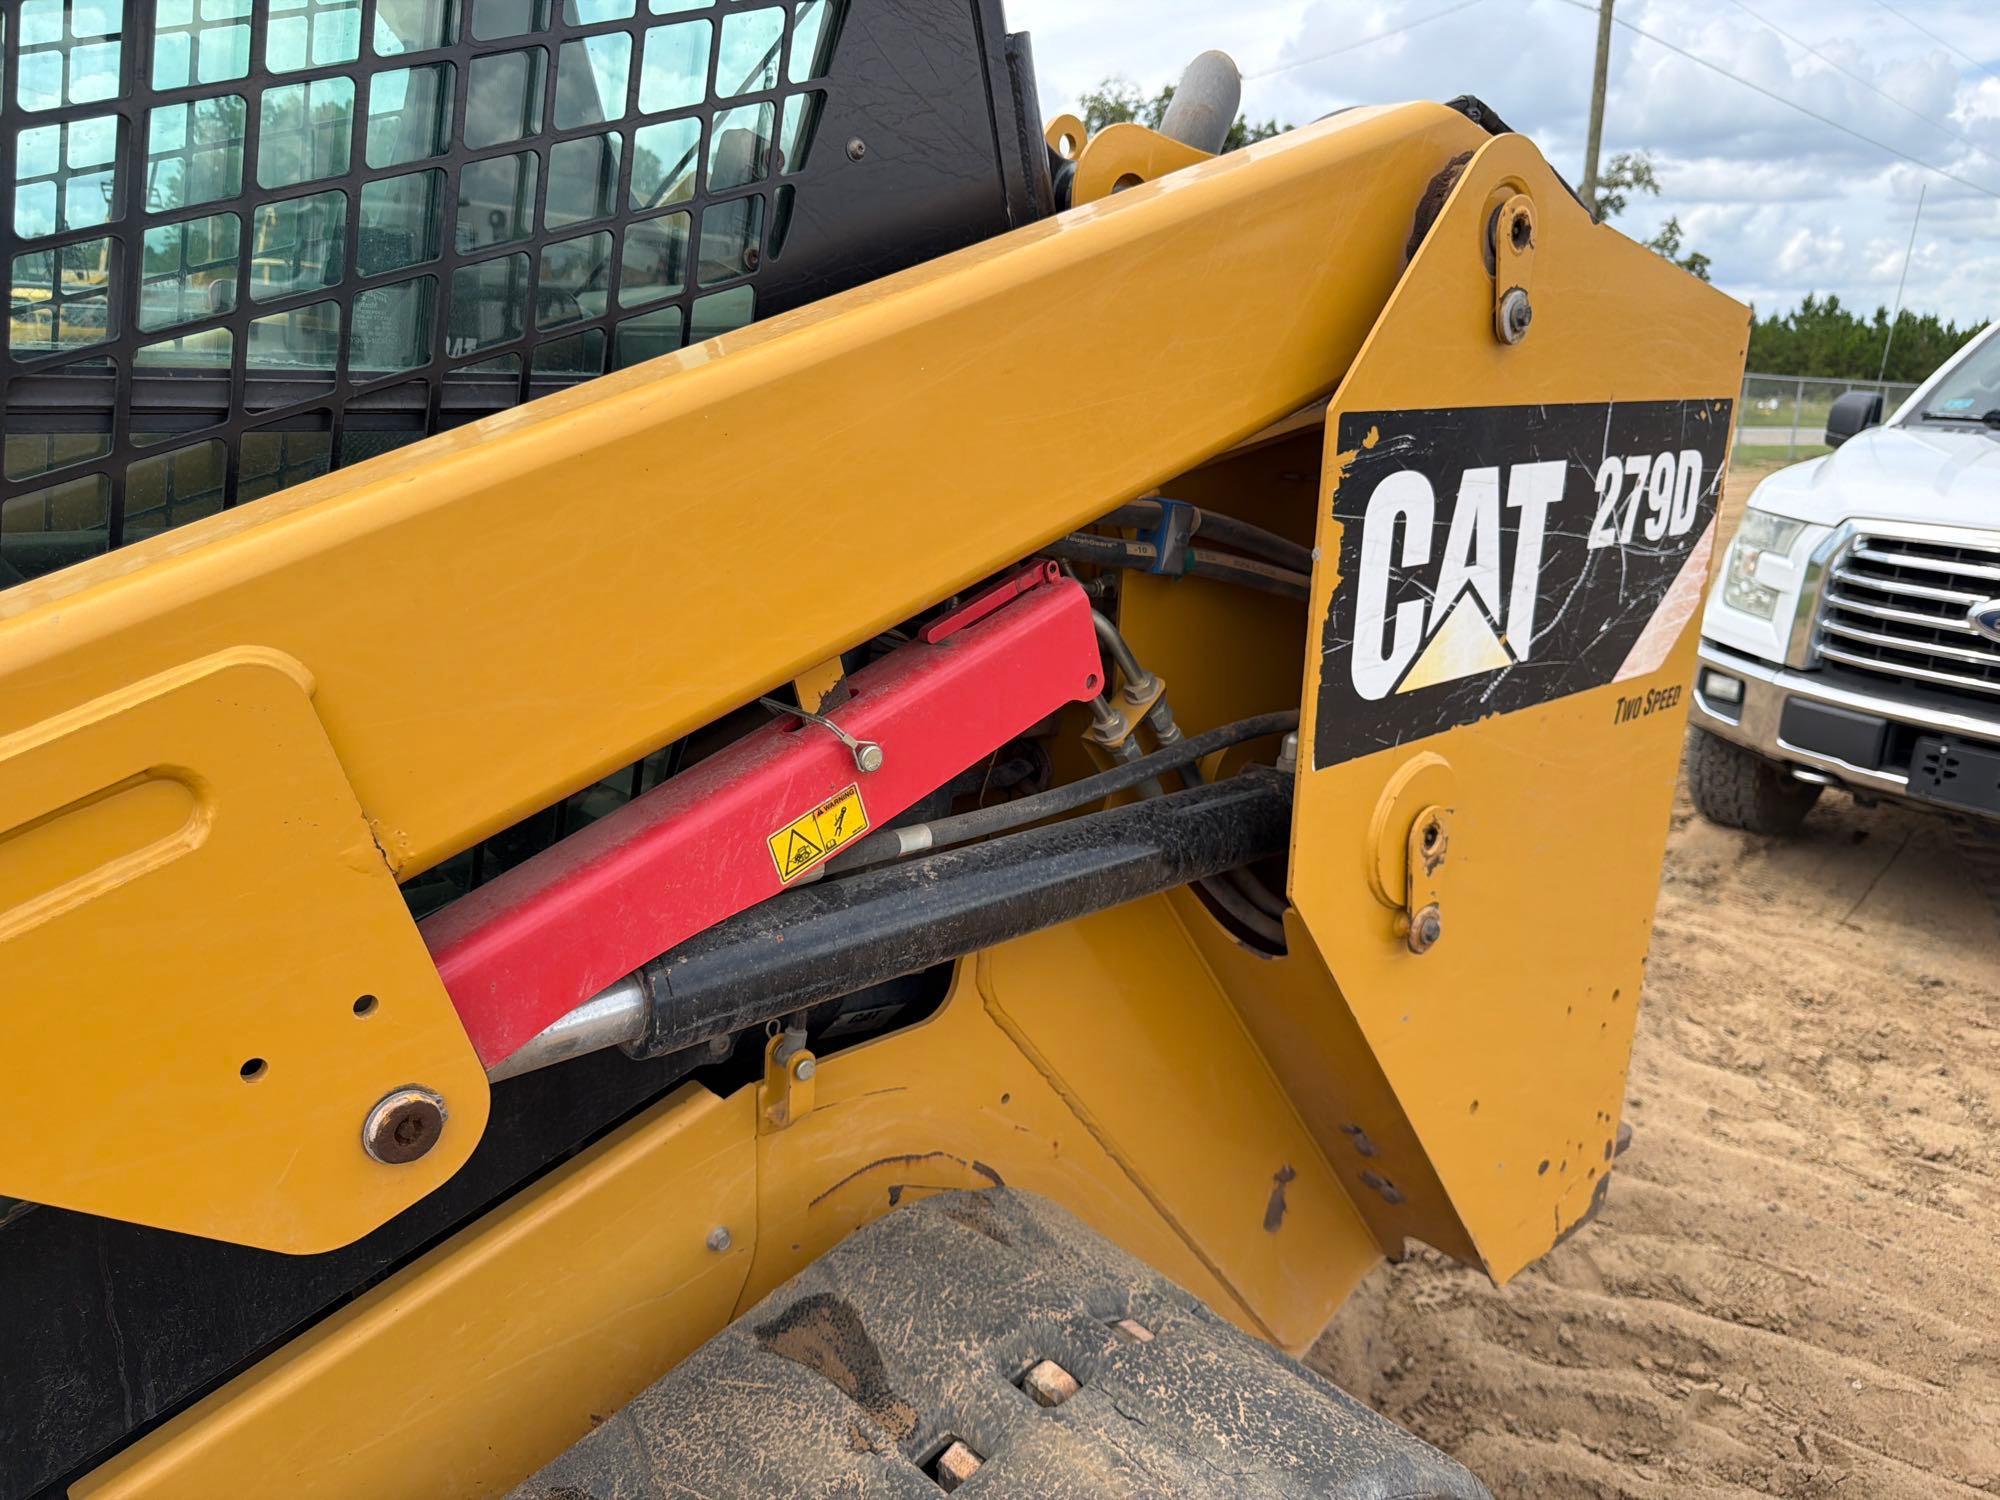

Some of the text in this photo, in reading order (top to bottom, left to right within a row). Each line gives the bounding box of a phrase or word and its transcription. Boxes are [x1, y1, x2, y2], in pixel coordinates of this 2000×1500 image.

[1587, 449, 1703, 550] 279D
[1351, 460, 1568, 701] CAT
[824, 788, 855, 812] WARNING
